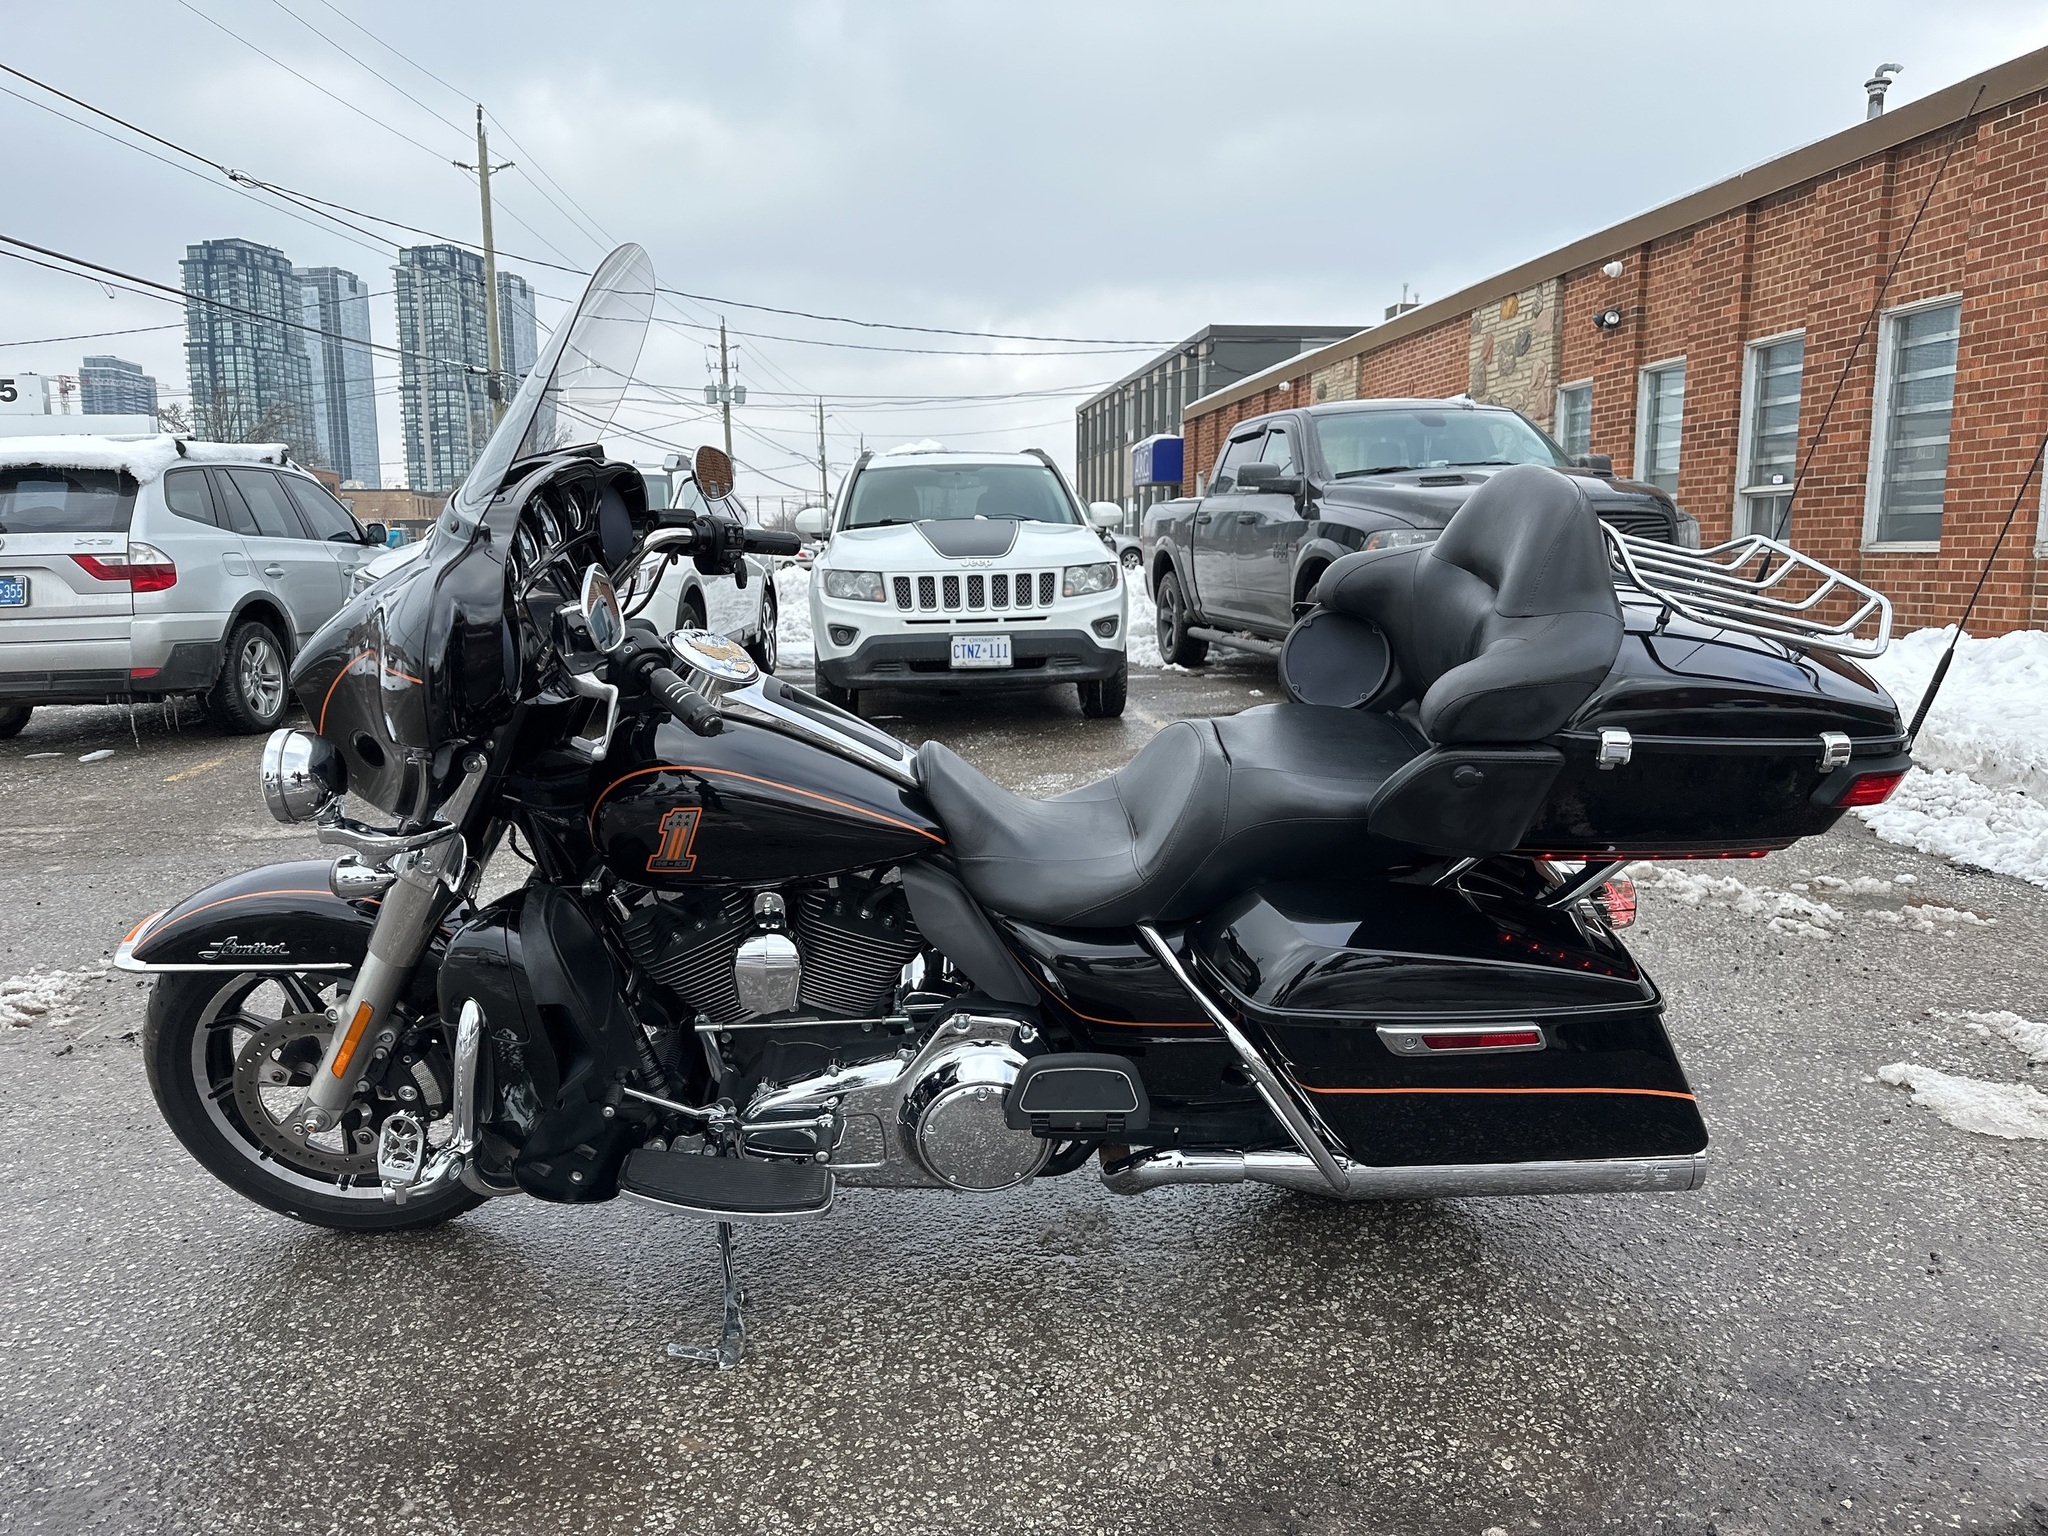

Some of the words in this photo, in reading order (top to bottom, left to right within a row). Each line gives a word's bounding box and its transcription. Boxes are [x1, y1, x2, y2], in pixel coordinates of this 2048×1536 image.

[0, 378, 18, 403] 5
[74, 538, 113, 546] X3
[961, 558, 993, 569] Jeep
[4, 584, 23, 598] 355
[953, 643, 981, 659] CTNZ
[198, 935, 290, 961] Limited
